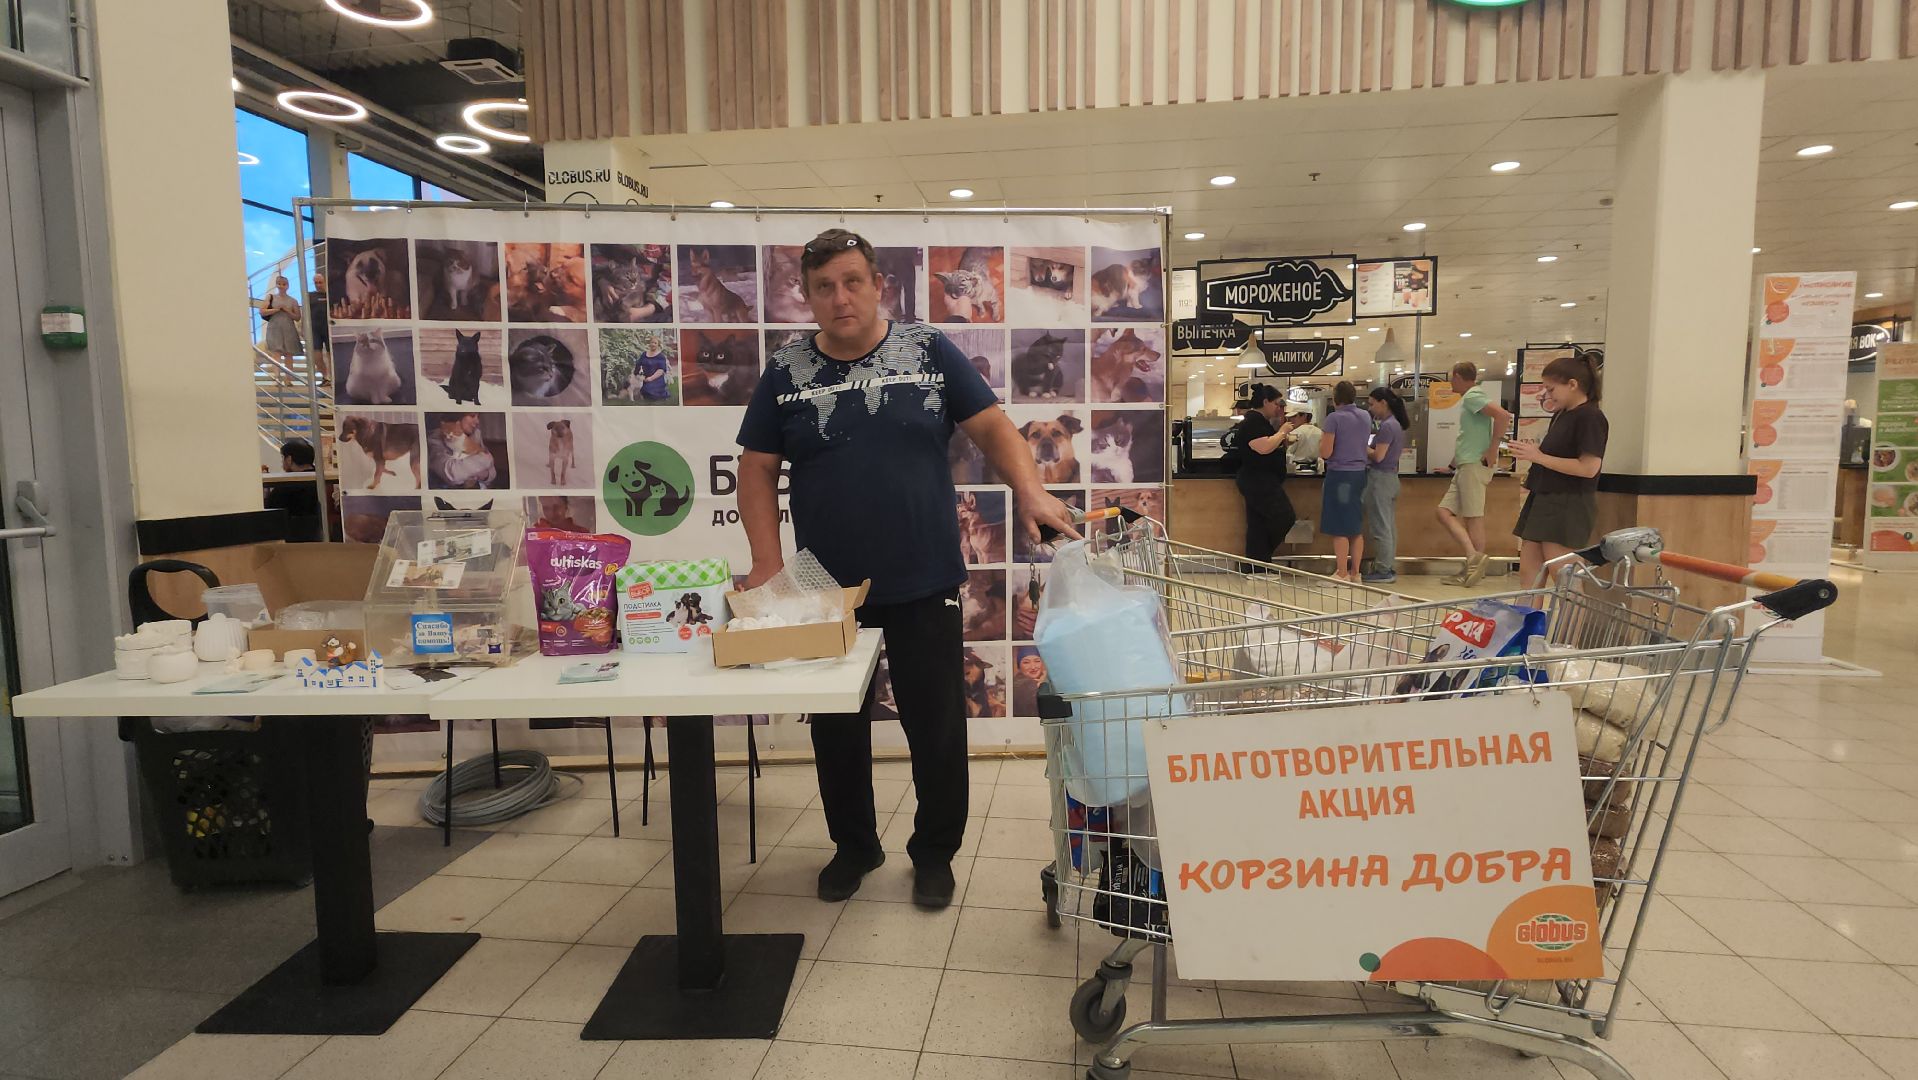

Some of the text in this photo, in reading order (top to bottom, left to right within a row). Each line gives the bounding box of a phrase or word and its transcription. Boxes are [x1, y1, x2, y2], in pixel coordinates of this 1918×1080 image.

[1225, 281, 1321, 305] МОРОЖЕНОЕ
[1177, 323, 1236, 340] ВЫПЕЧКА
[1272, 351, 1314, 363] НАПИТКИ
[881, 376, 897, 384] KEEP
[811, 388, 826, 396] KEEP
[550, 554, 603, 570] whiskas
[623, 601, 662, 610] ПОДСТИЛКА
[416, 622, 449, 630] Спасибо
[1167, 731, 1552, 783] БЛАГОТВОРИТЕЛЬНАЯ
[1298, 785, 1415, 821] АКЦИЯ
[1178, 847, 1572, 893] КОРЗИНА ДОБРА
[1517, 920, 1587, 942] Globus
